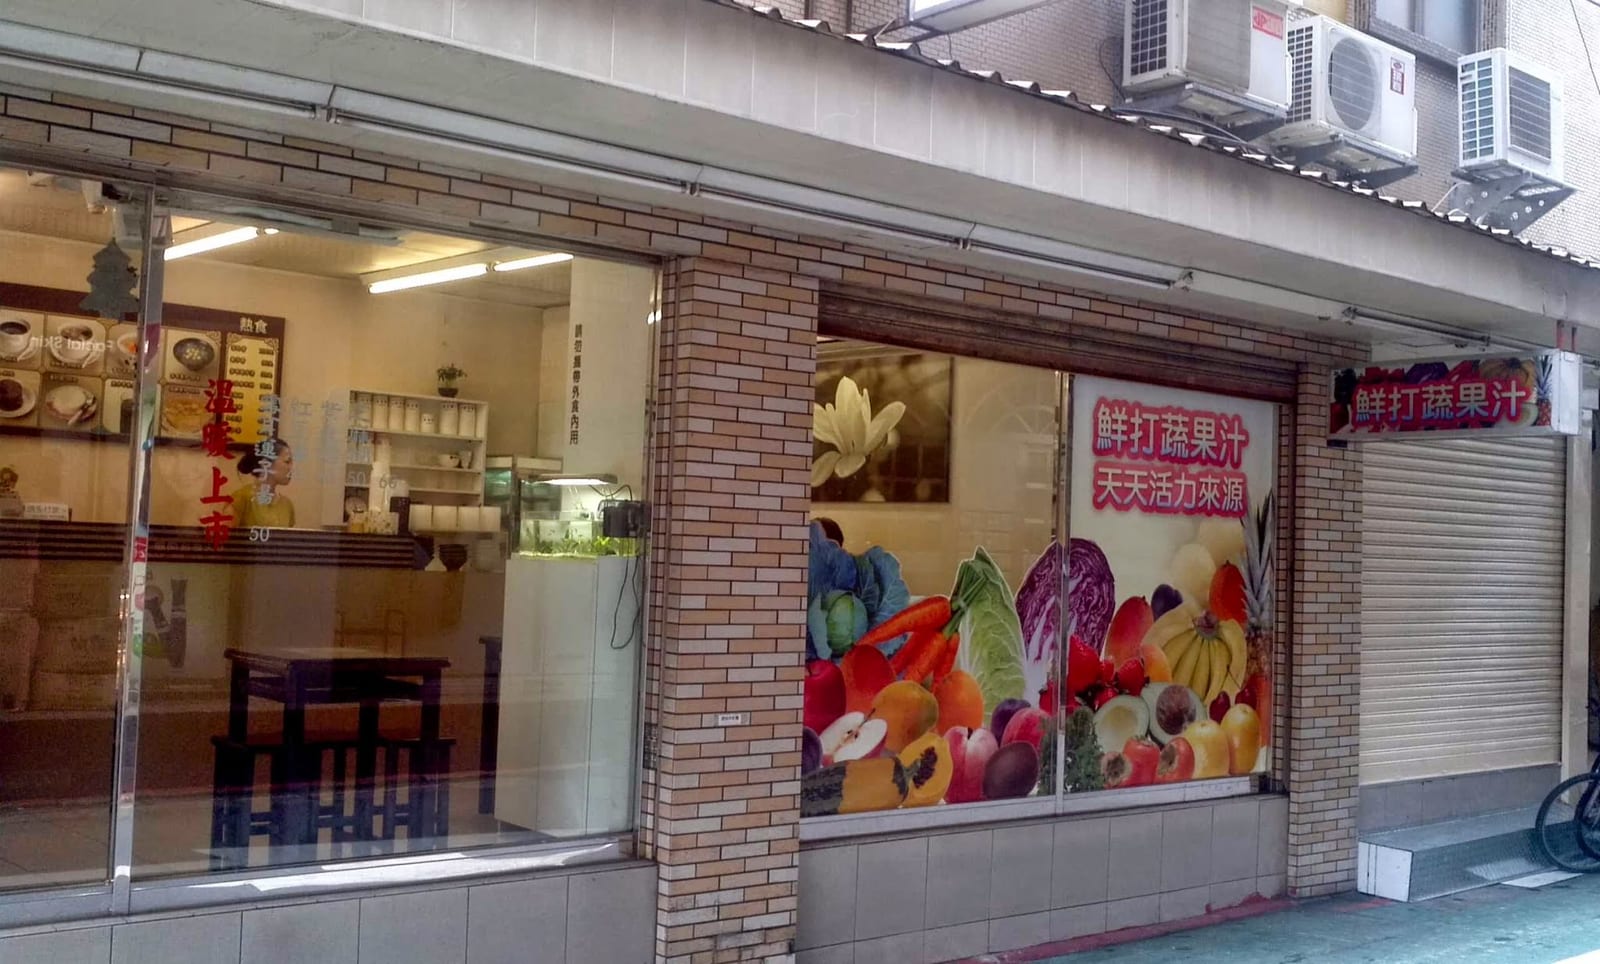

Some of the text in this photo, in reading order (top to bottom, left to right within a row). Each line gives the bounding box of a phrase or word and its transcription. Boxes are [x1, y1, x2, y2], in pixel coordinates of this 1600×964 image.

[1355, 380, 1528, 423] 鮮打蔬果汁
[1096, 405, 1247, 468] 鮮打蔬果汁
[1096, 468, 1245, 512] 天天活力來源
[249, 526, 271, 543] 50
